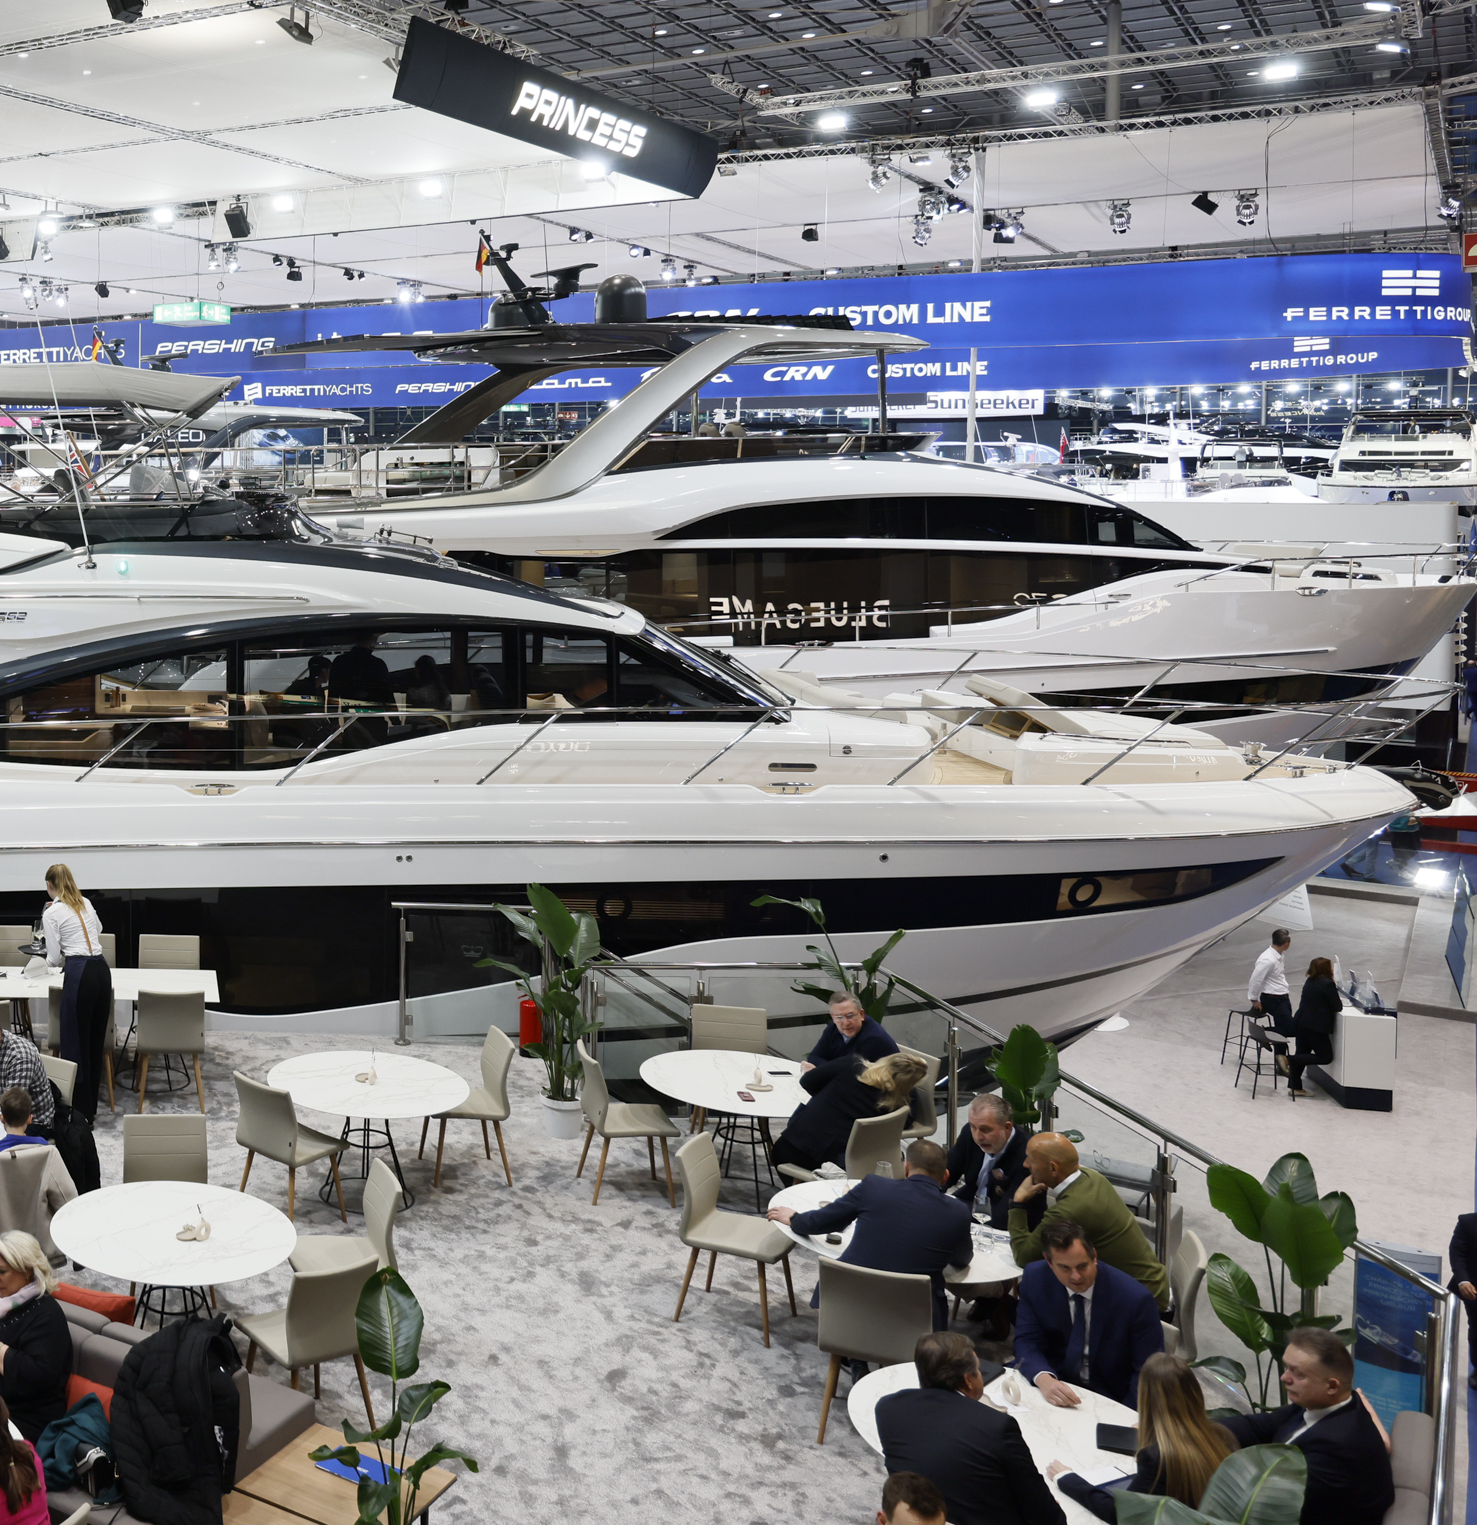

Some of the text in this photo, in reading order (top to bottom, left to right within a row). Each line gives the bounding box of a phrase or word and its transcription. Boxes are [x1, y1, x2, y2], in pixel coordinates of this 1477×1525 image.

[511, 81, 647, 158] PRINCESS
[926, 300, 991, 324] LINE
[1283, 306, 1471, 321] FERRETTIGROUP
[155, 337, 276, 356] PERSHING
[945, 361, 988, 376] LINE
[1250, 352, 1378, 371] FERRETTIGROUP
[763, 365, 835, 382] CRN
[265, 383, 372, 397] FERRETTIYACHTS
[395, 381, 481, 394] PERSHIN
